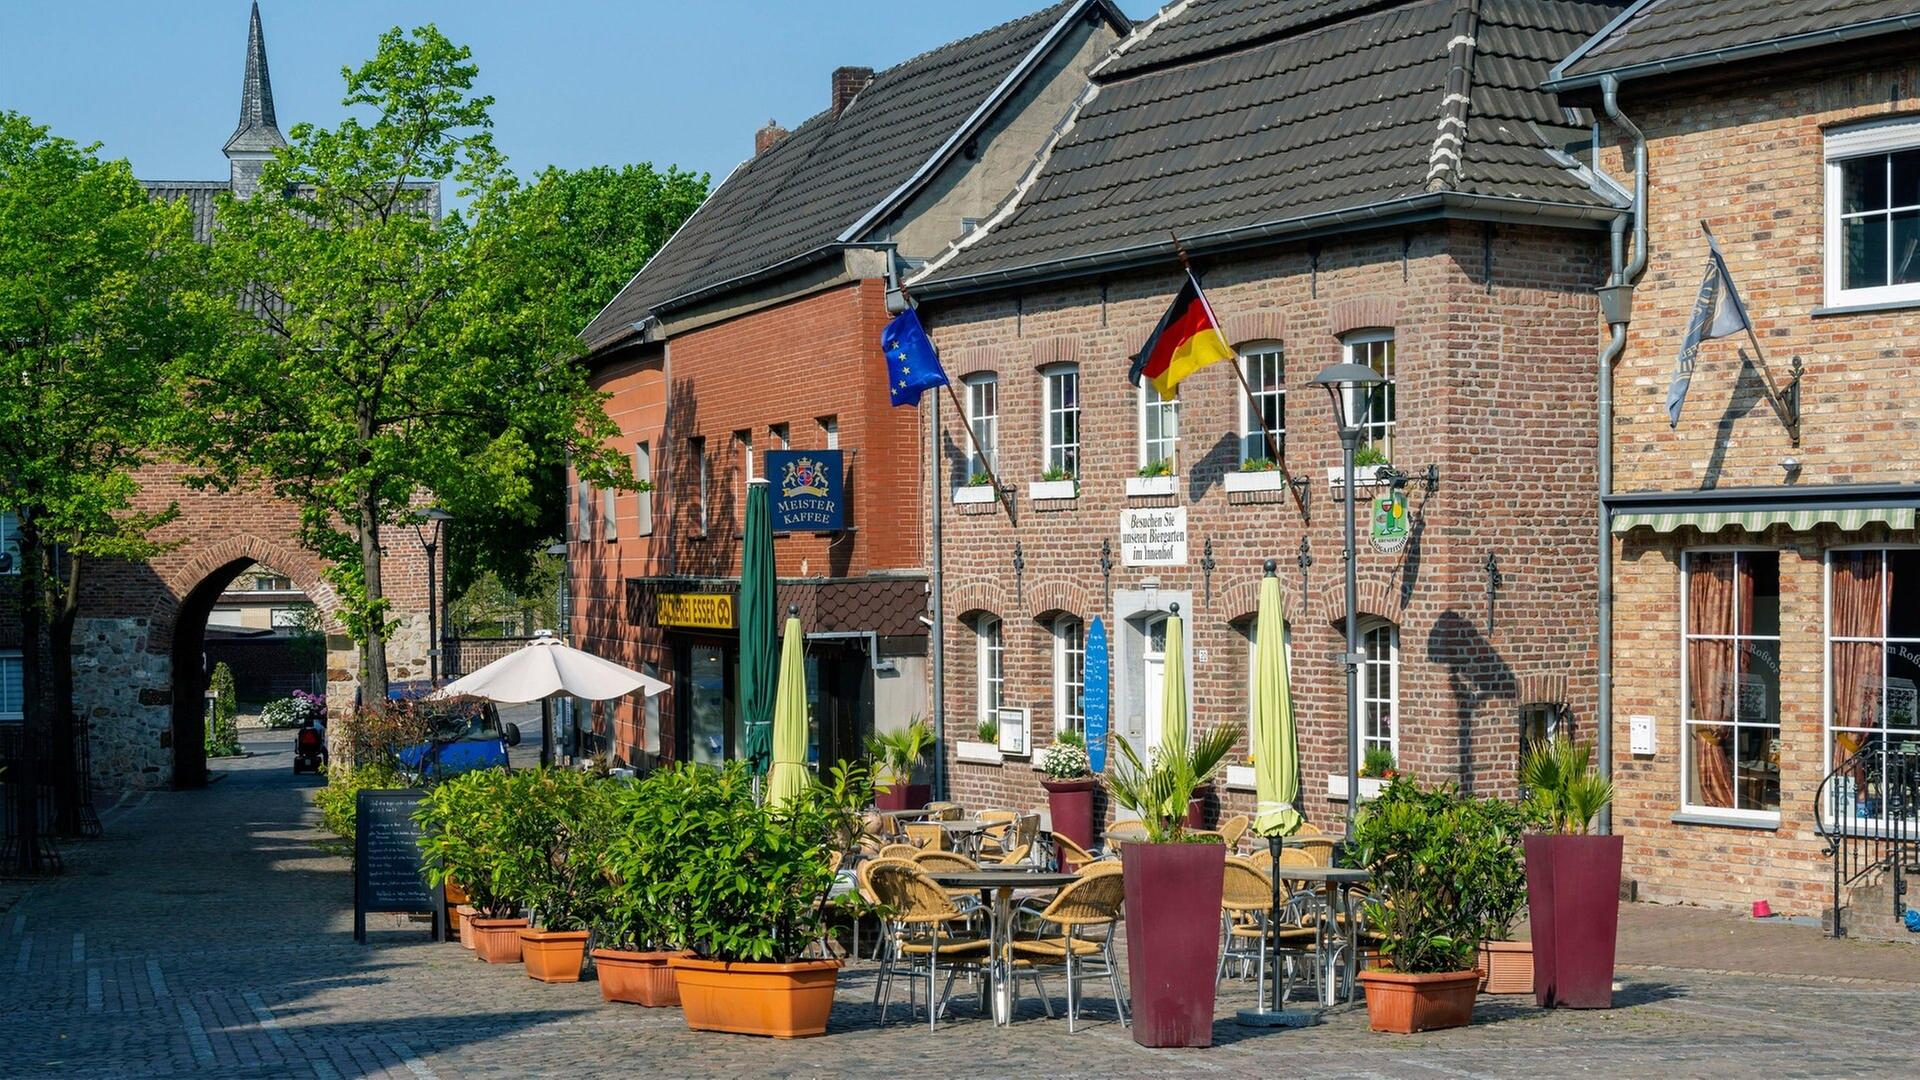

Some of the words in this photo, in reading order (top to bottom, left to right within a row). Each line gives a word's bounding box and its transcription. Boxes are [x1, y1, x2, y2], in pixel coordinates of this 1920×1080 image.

[778, 500, 835, 513] MEISTER
[784, 512, 830, 524] KAFFEE
[1131, 514, 1163, 528] Besuchen
[1164, 512, 1175, 527] Sie
[1123, 533, 1148, 543] unseren
[1149, 529, 1185, 545] Biergarten
[1133, 546, 1143, 560] im
[1144, 545, 1174, 560] Innenhof
[693, 599, 716, 624] ESSER
[1749, 643, 1780, 673] Roßtor
[1899, 645, 1920, 668] Roß
